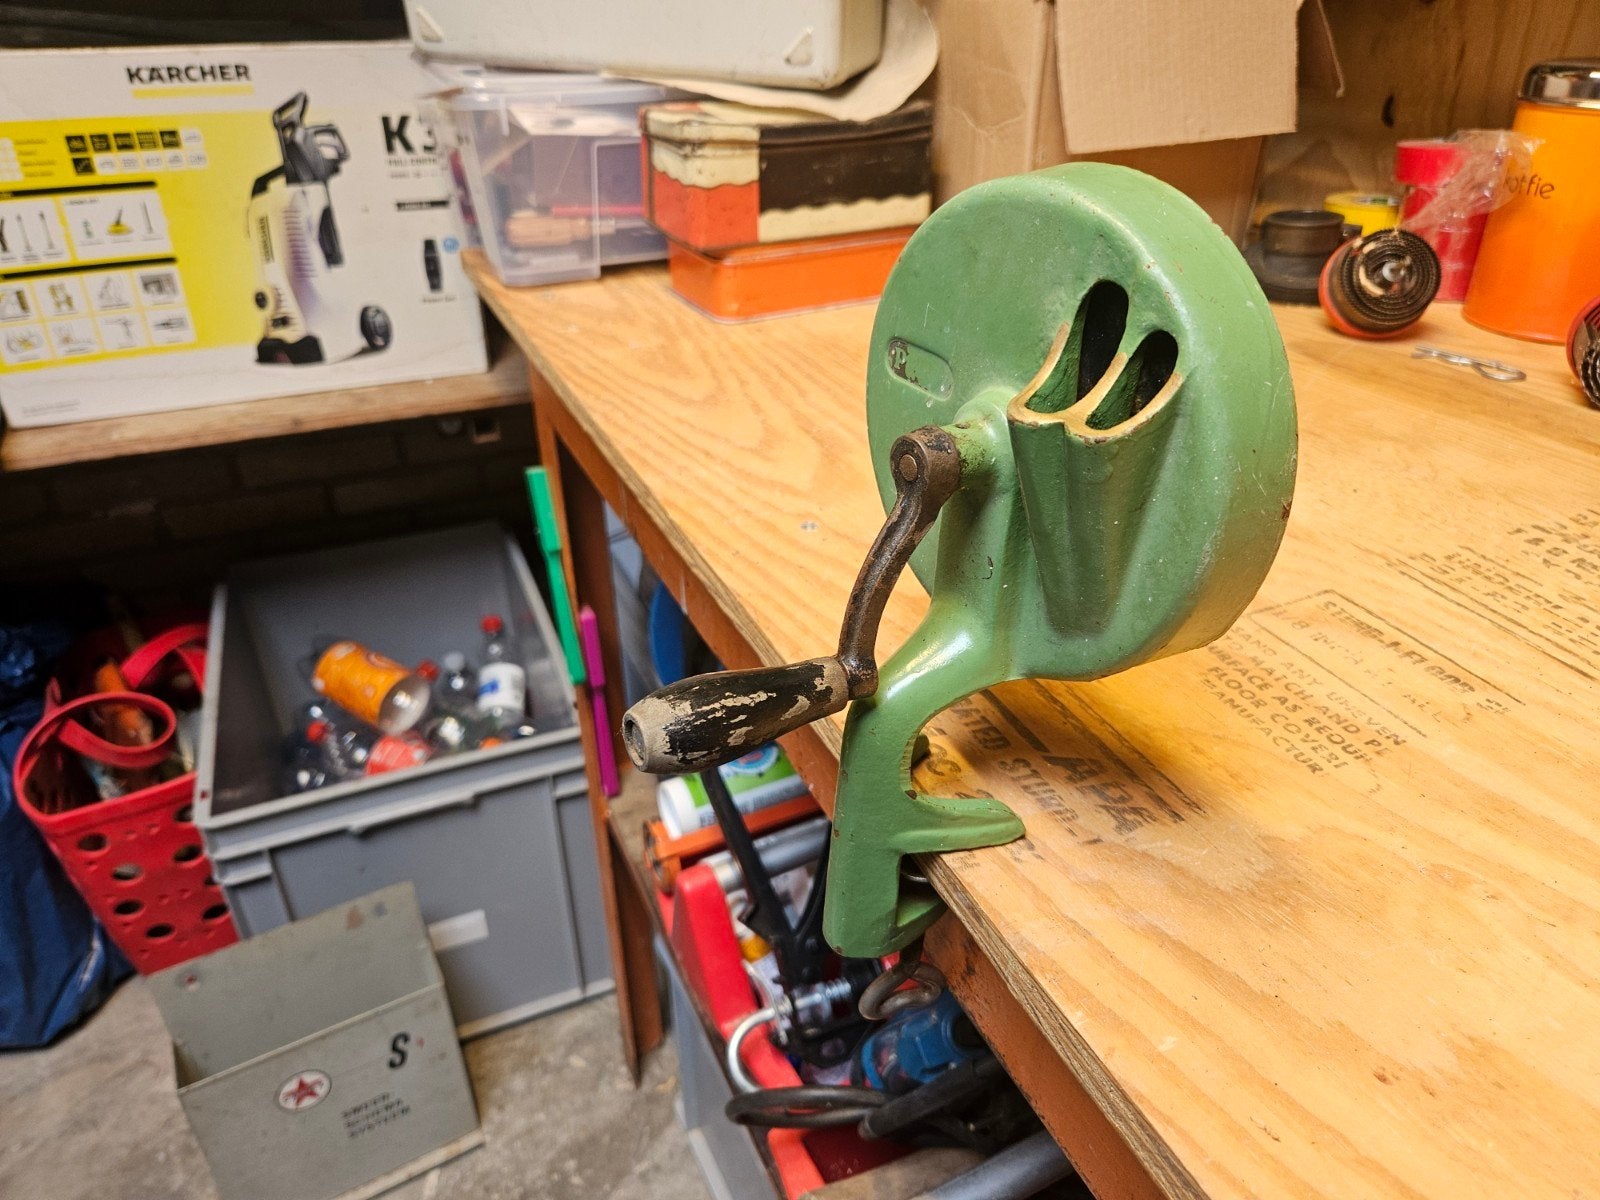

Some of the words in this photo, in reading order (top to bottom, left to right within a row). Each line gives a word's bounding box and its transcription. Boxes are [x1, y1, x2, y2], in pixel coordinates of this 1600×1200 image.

[1206, 645, 1274, 692] URFACE
[1206, 666, 1268, 709] FLOOR
[1313, 705, 1361, 734] AND
[388, 1031, 412, 1069] S
